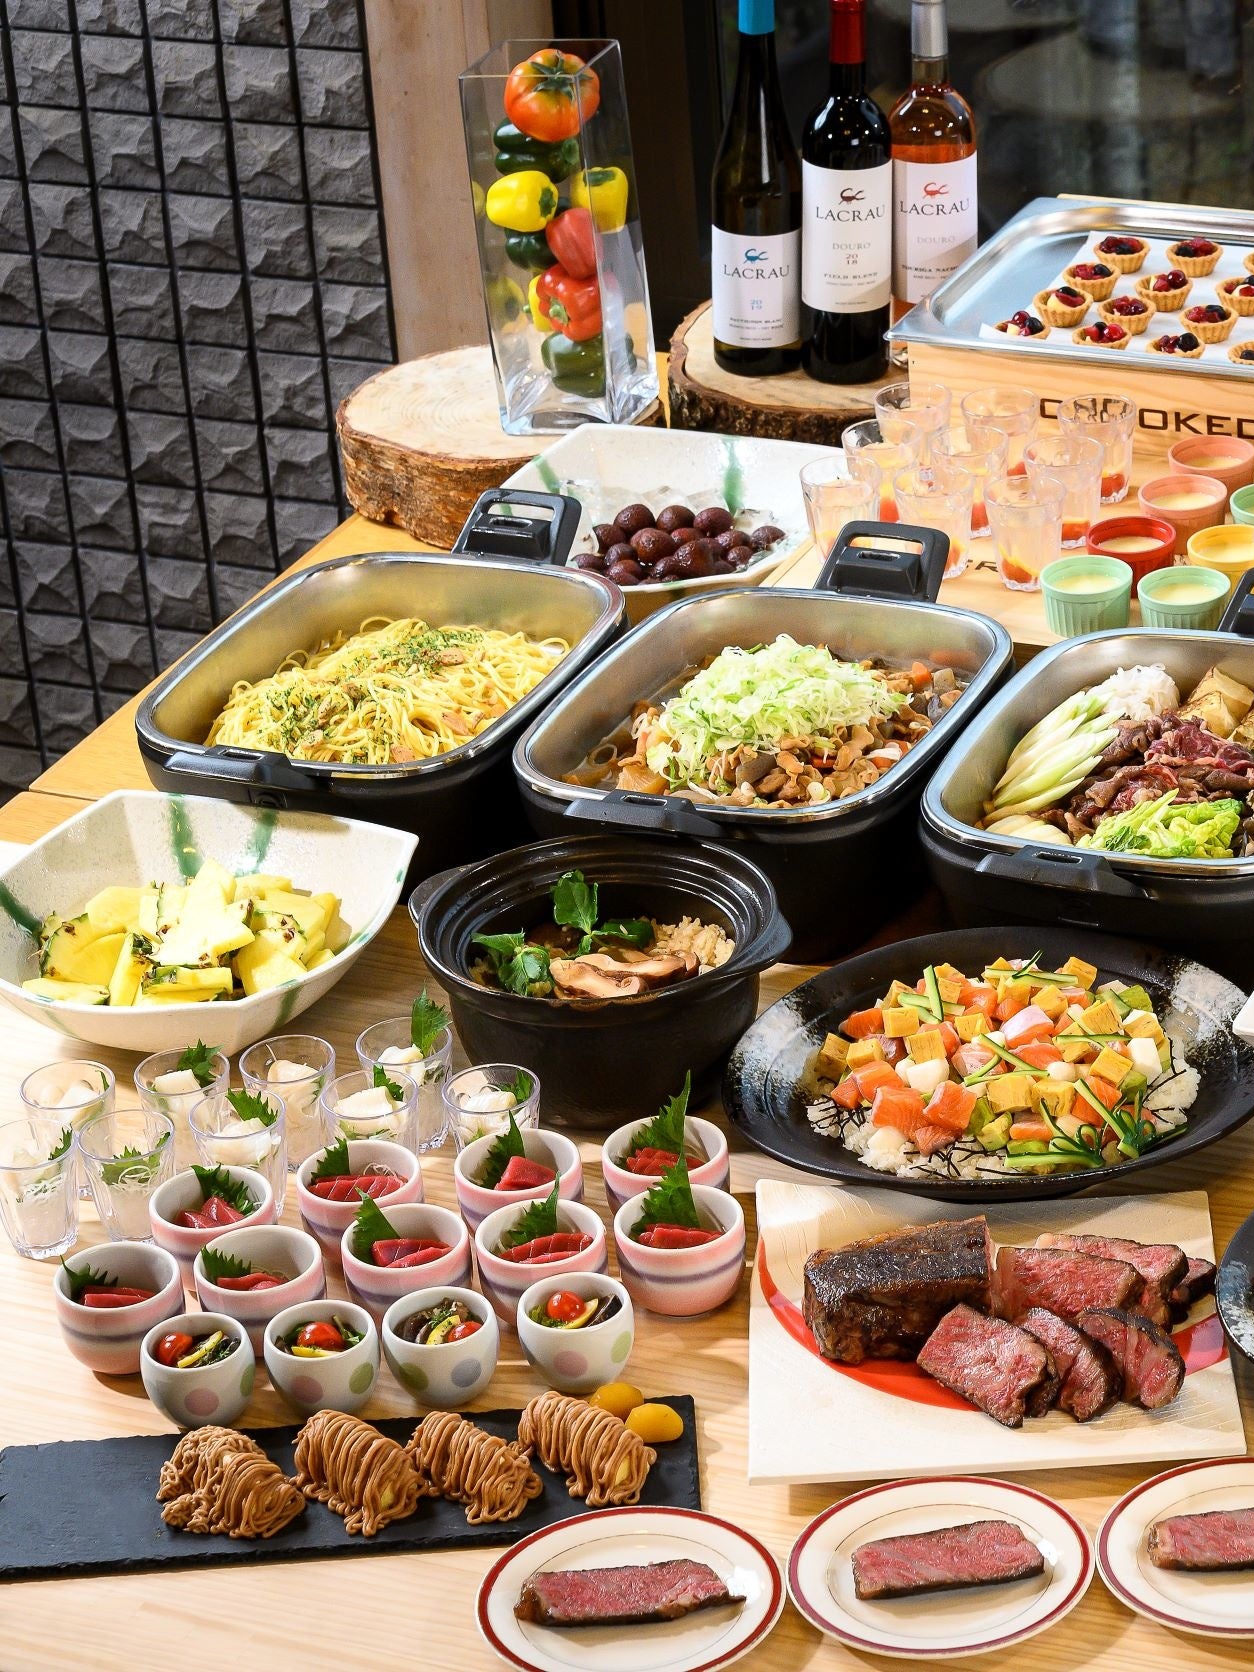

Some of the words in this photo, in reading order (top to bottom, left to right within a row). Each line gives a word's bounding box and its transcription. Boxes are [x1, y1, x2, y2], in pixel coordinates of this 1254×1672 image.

[815, 204, 886, 222] LACRAU
[899, 198, 970, 216] LACRAU
[832, 242, 871, 250] DOURO
[916, 236, 956, 244] DOURO
[723, 264, 790, 279] LACRAU
